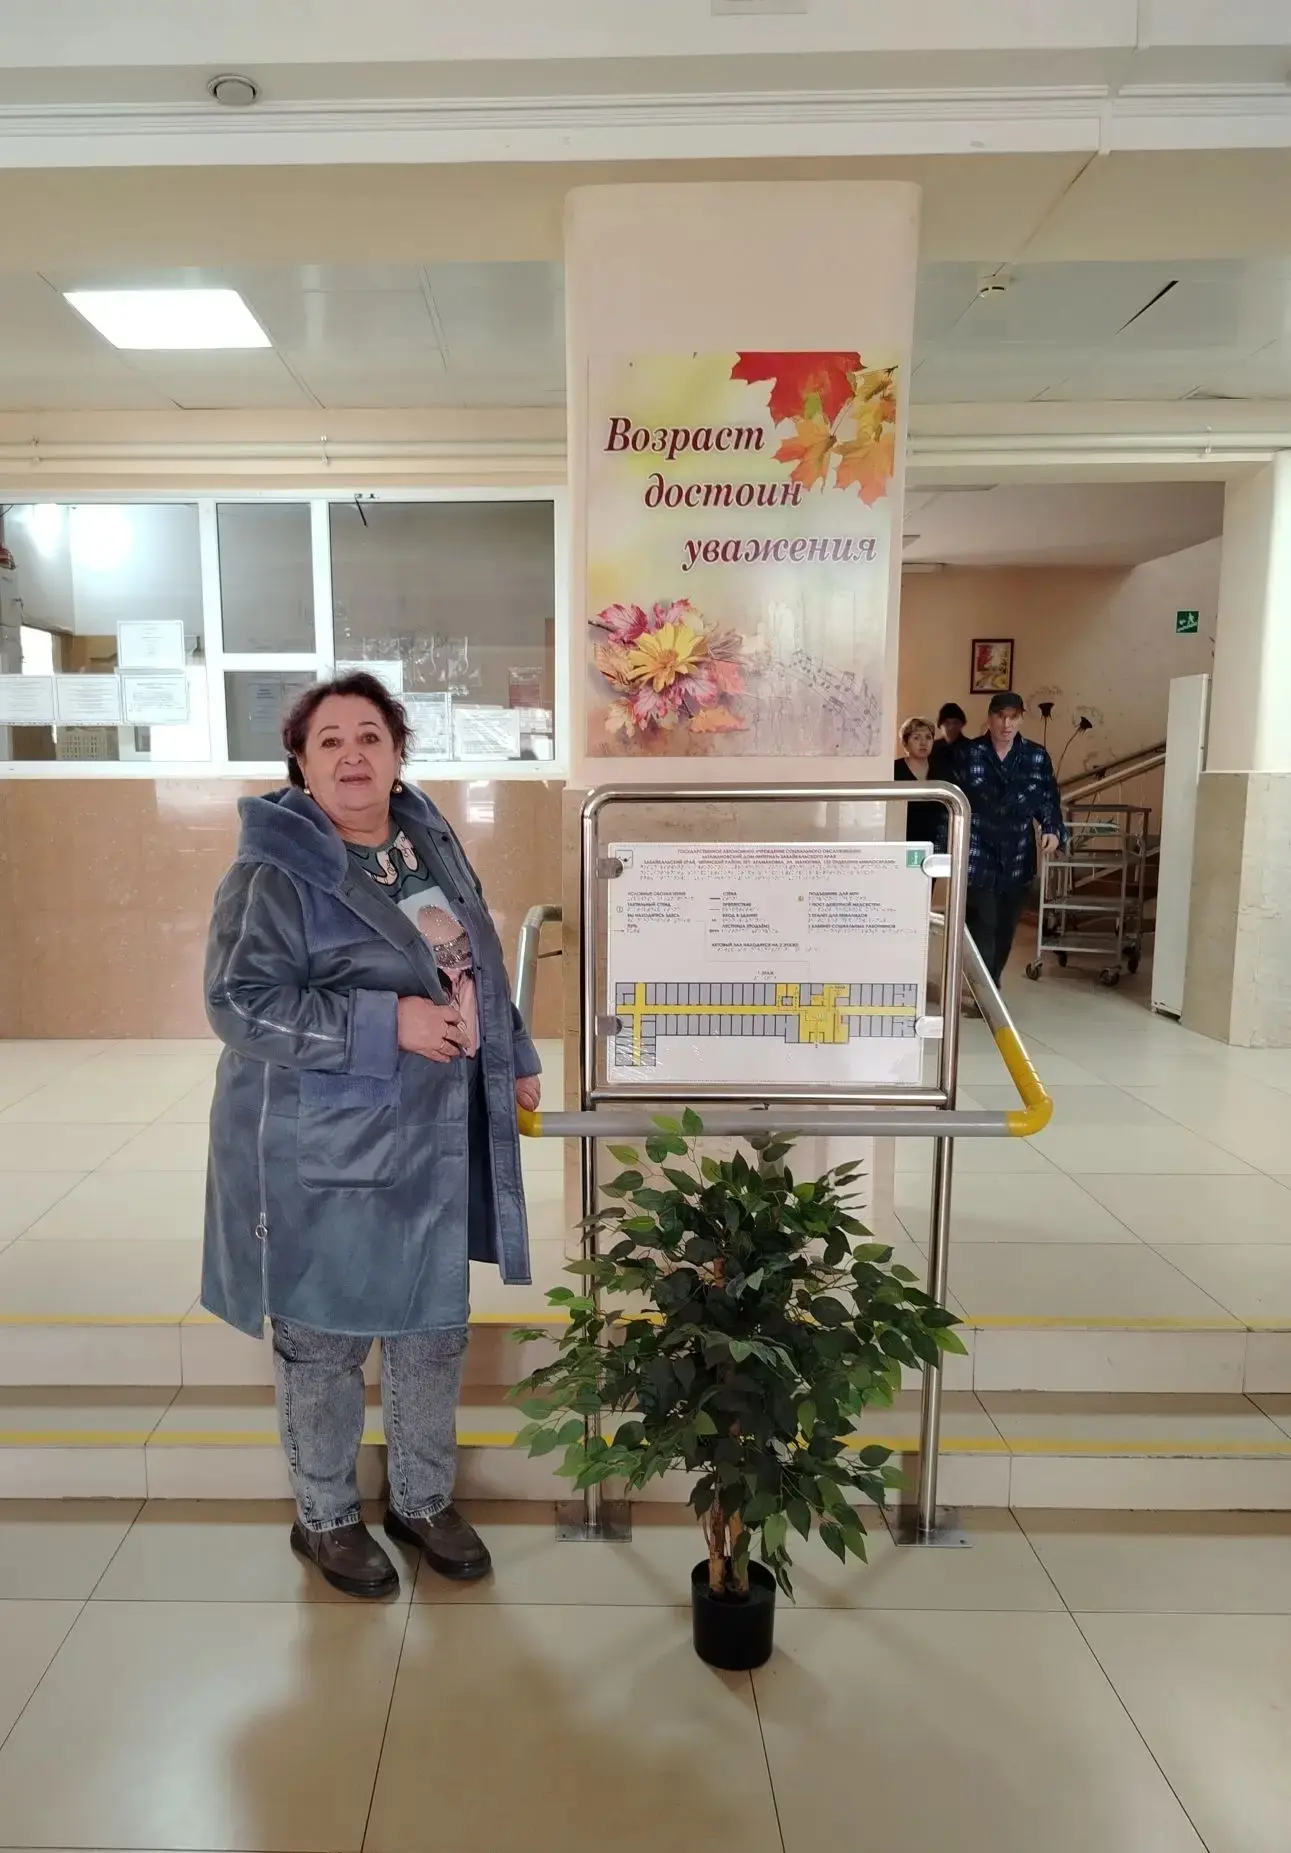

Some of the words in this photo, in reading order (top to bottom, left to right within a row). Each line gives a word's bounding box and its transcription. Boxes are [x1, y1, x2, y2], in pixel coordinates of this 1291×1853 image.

[604, 416, 766, 461] Возраст
[643, 472, 804, 509] достоин
[680, 535, 878, 573] уважения
